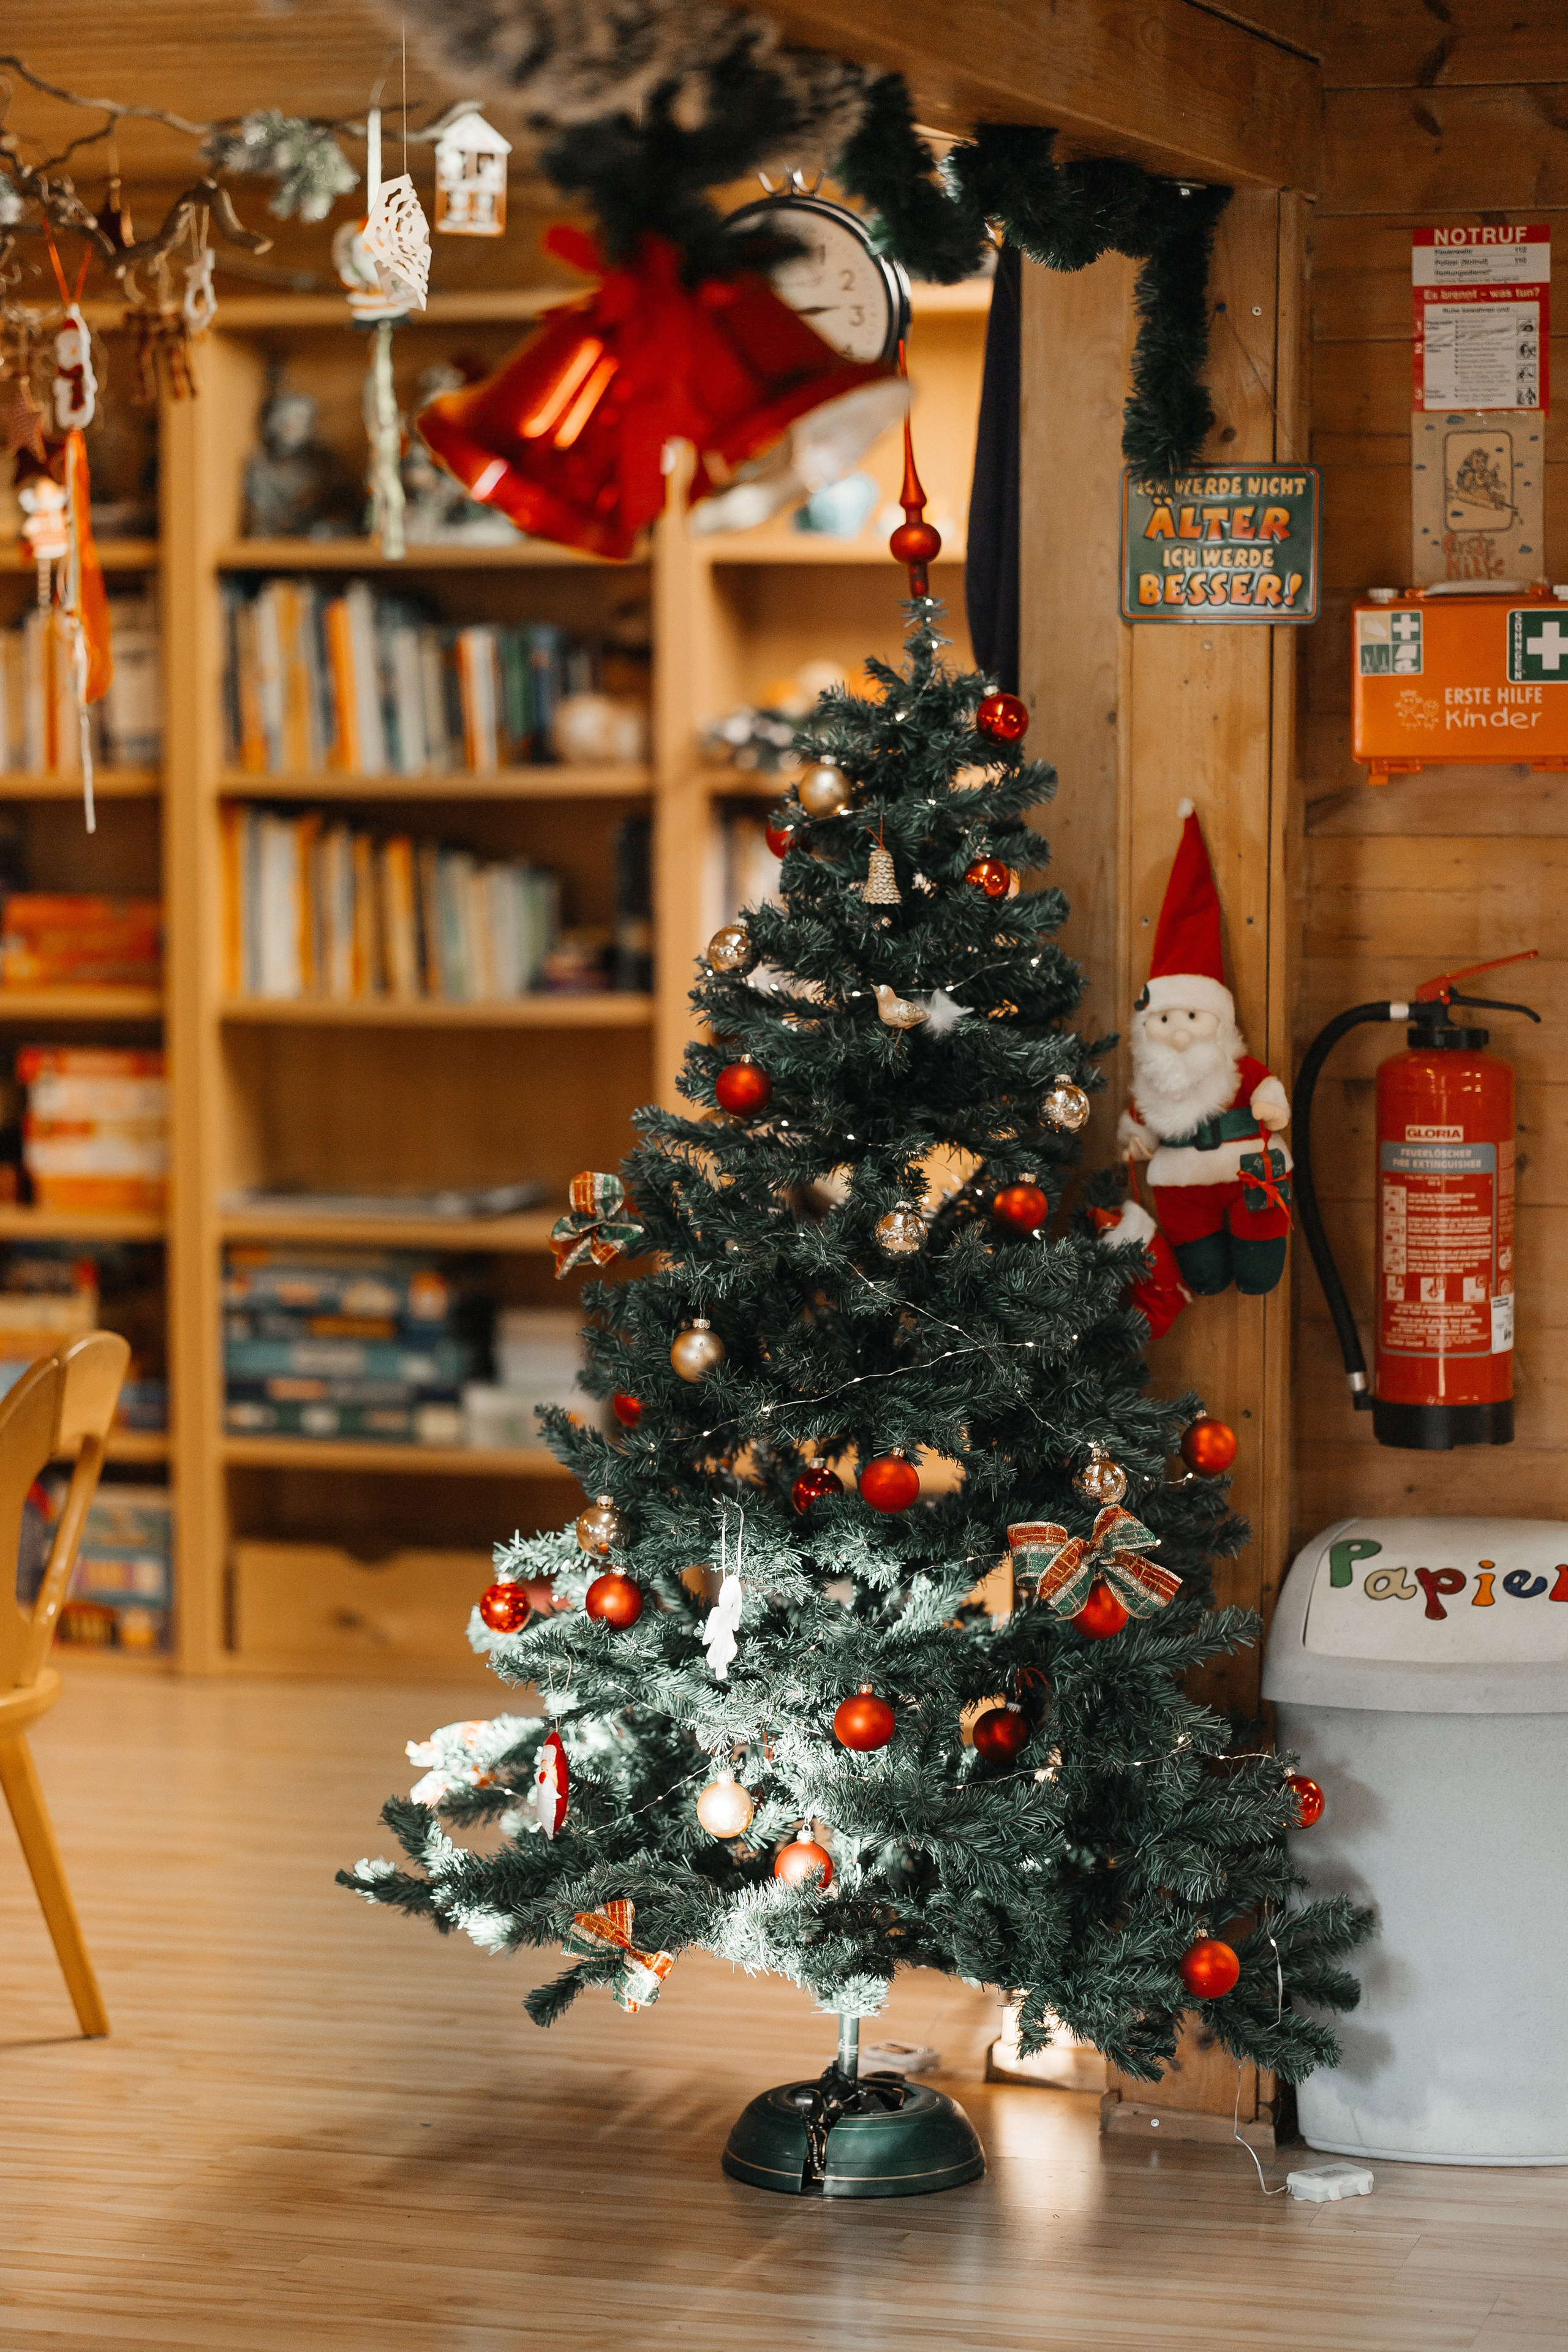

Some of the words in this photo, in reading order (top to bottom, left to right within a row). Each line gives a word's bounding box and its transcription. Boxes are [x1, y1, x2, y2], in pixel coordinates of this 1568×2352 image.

[1434, 227, 1528, 245] NOTRUF
[840, 268, 856, 292] 2
[1490, 288, 1512, 298] was
[1515, 287, 1540, 298] tun?
[850, 304, 865, 326] 3
[1175, 477, 1242, 496] WERDE
[1247, 477, 1306, 496] NICHT
[1145, 497, 1291, 541] ÄLTER
[1163, 549, 1196, 568] ICH
[1202, 548, 1275, 568] WERDE
[1139, 573, 1302, 606] BESSER!
[1444, 687, 1491, 705] ERSTE
[1497, 687, 1543, 704] HILFE
[1445, 706, 1542, 730] Kinder
[1407, 1128, 1461, 1139] GLORIA
